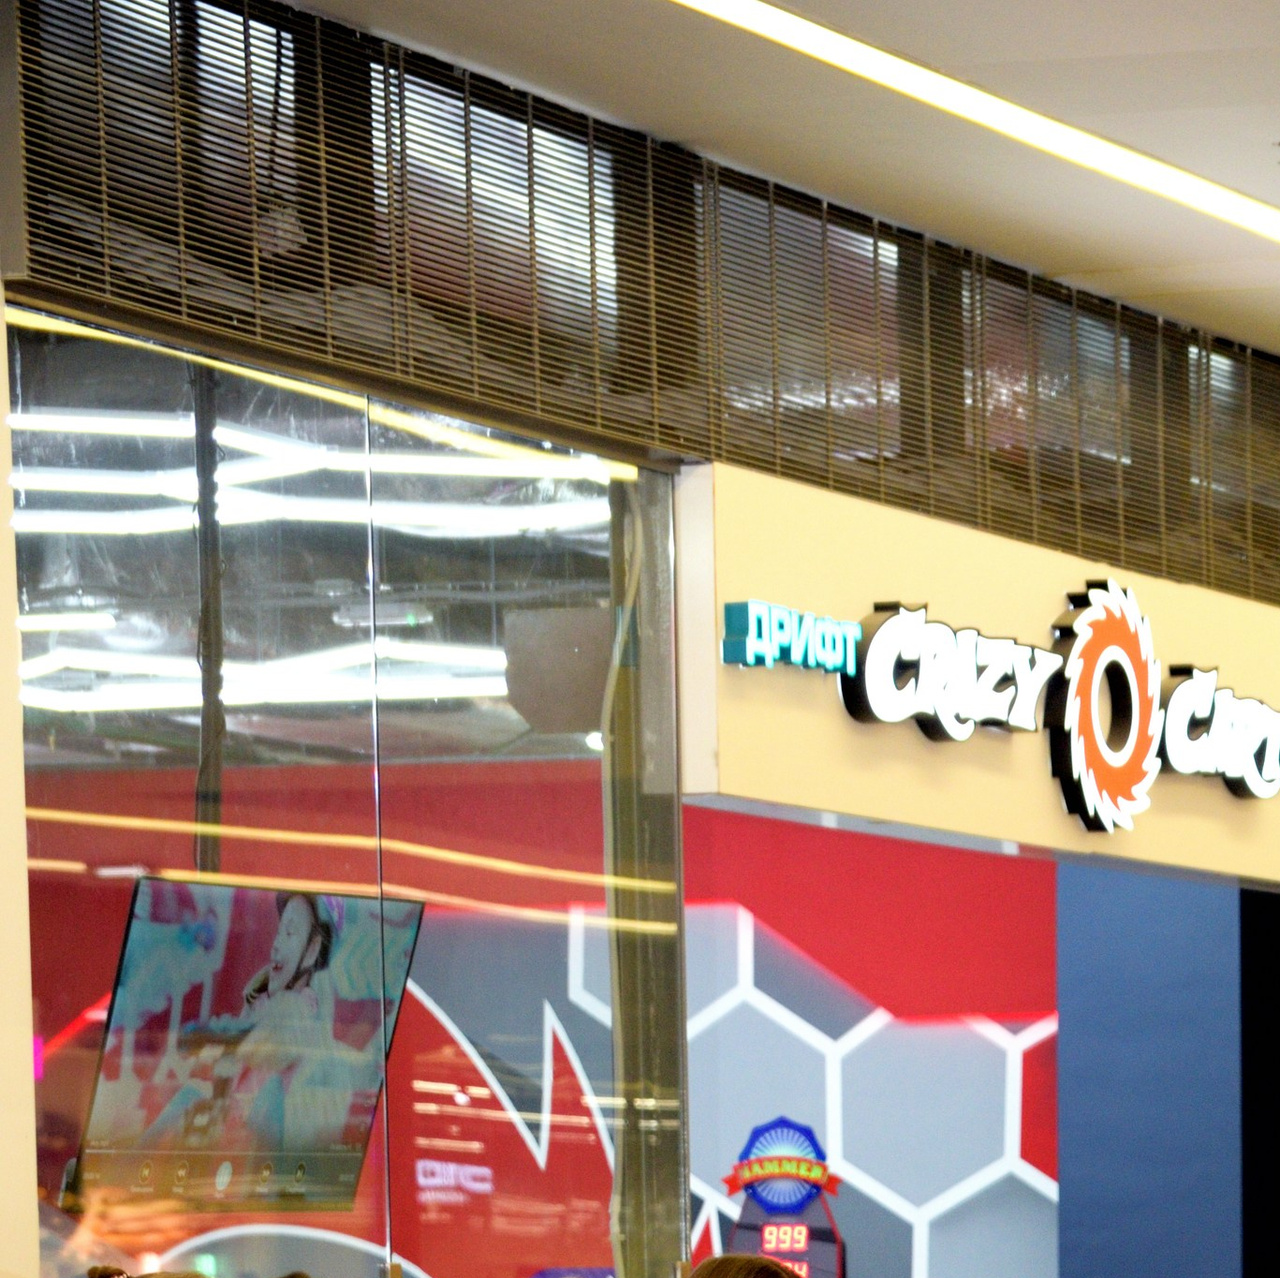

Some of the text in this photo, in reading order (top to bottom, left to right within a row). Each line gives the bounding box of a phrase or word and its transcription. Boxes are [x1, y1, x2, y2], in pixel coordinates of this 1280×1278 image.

[744, 599, 862, 678] ДРИФТ
[864, 605, 1064, 742] CRAZY
[762, 1224, 809, 1251] 999
